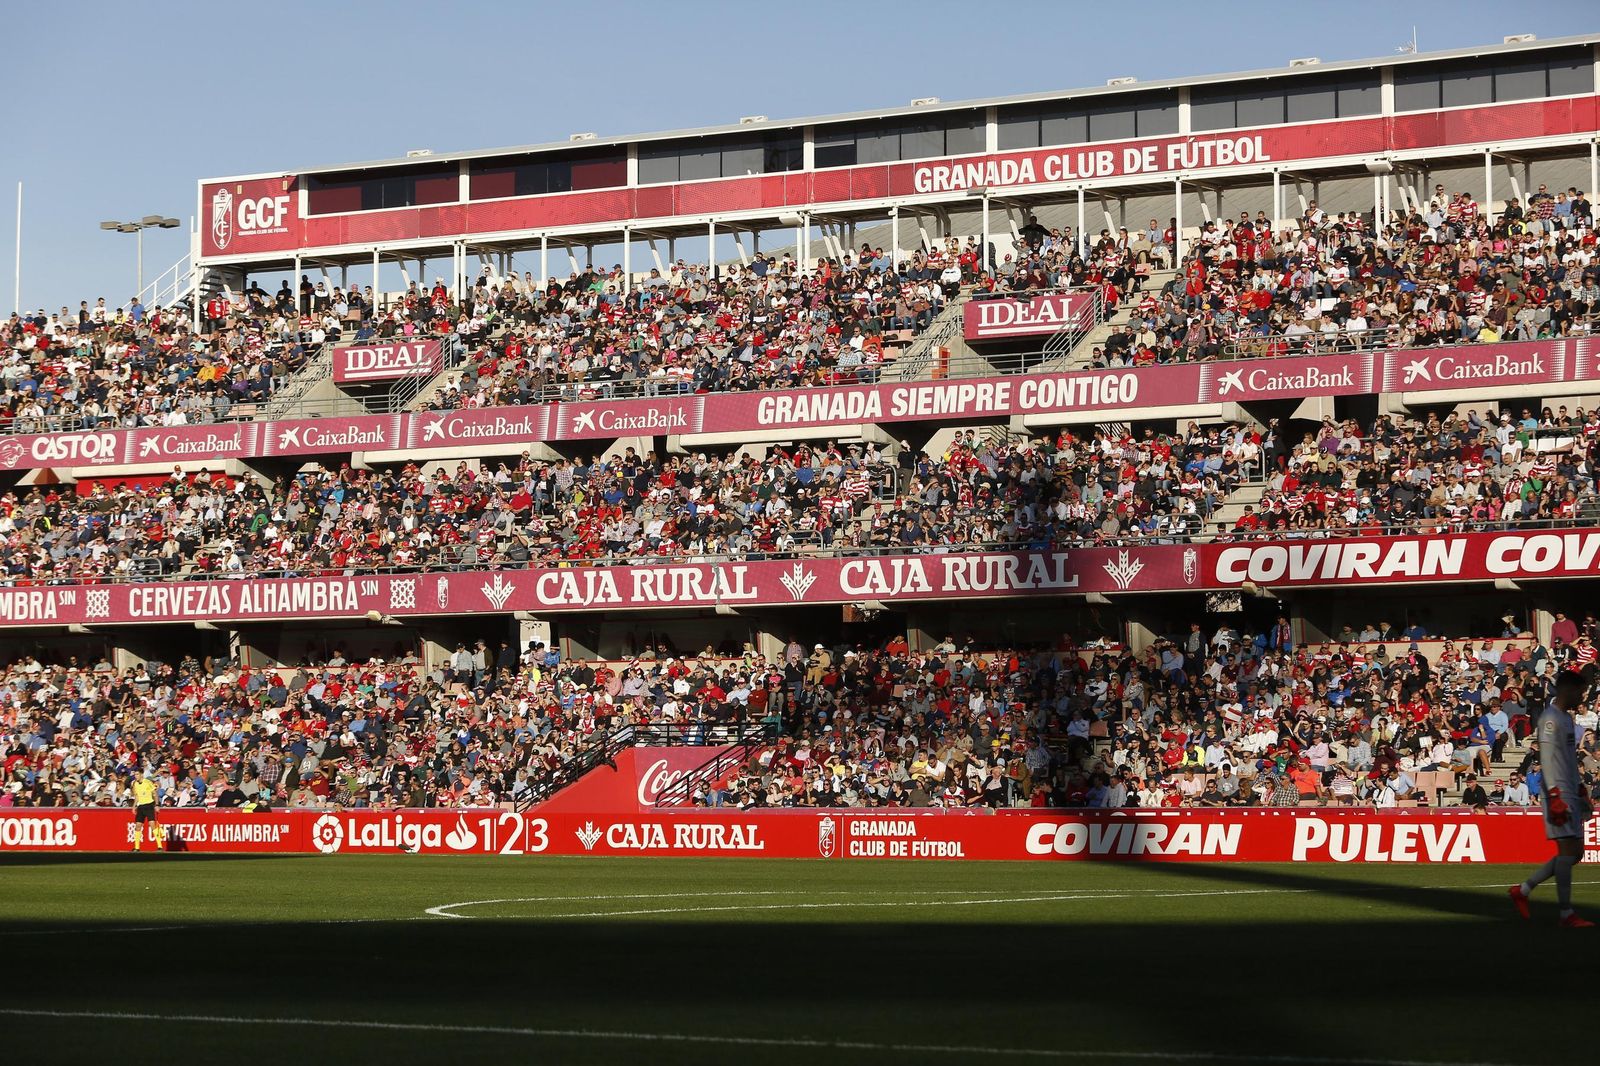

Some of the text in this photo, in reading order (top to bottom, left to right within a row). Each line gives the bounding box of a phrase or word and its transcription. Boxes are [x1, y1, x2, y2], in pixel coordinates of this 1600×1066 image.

[914, 136, 1271, 193] GRANADA CLUB DE FÚTBOL
[237, 196, 290, 230] GCF
[977, 298, 1081, 328] IDEAL
[344, 345, 432, 372] IDEAL
[1434, 352, 1545, 380] CaixaBank
[1248, 365, 1355, 391] CaixaBank
[757, 373, 1139, 424] GRANADA SIEMPRE CONTIGO
[448, 418, 533, 439] CaixaBank
[598, 407, 688, 431] CaixaBank
[31, 434, 117, 461] CASTOR
[163, 433, 242, 454] CaixaBank
[303, 424, 385, 447] CaixaBank
[1215, 539, 1467, 583] COVIRAN
[1485, 533, 1600, 573] COV
[536, 566, 757, 606] CAJA RURAL
[839, 553, 1079, 596] CAJA RURAL
[59, 591, 76, 605] SIN
[129, 579, 379, 616] CERVEZAS ALHAMBRA SIN
[211, 824, 280, 842] ALHAMBRA
[280, 824, 290, 833] SIN
[348, 815, 442, 852] LaLiga
[606, 823, 765, 850] CAJA RURAL
[850, 820, 916, 836] GRANADA
[1025, 822, 1243, 855] COVIRAN
[1292, 817, 1486, 862] PULEVA
[850, 837, 965, 857] CLUB DE FÚTBOL
